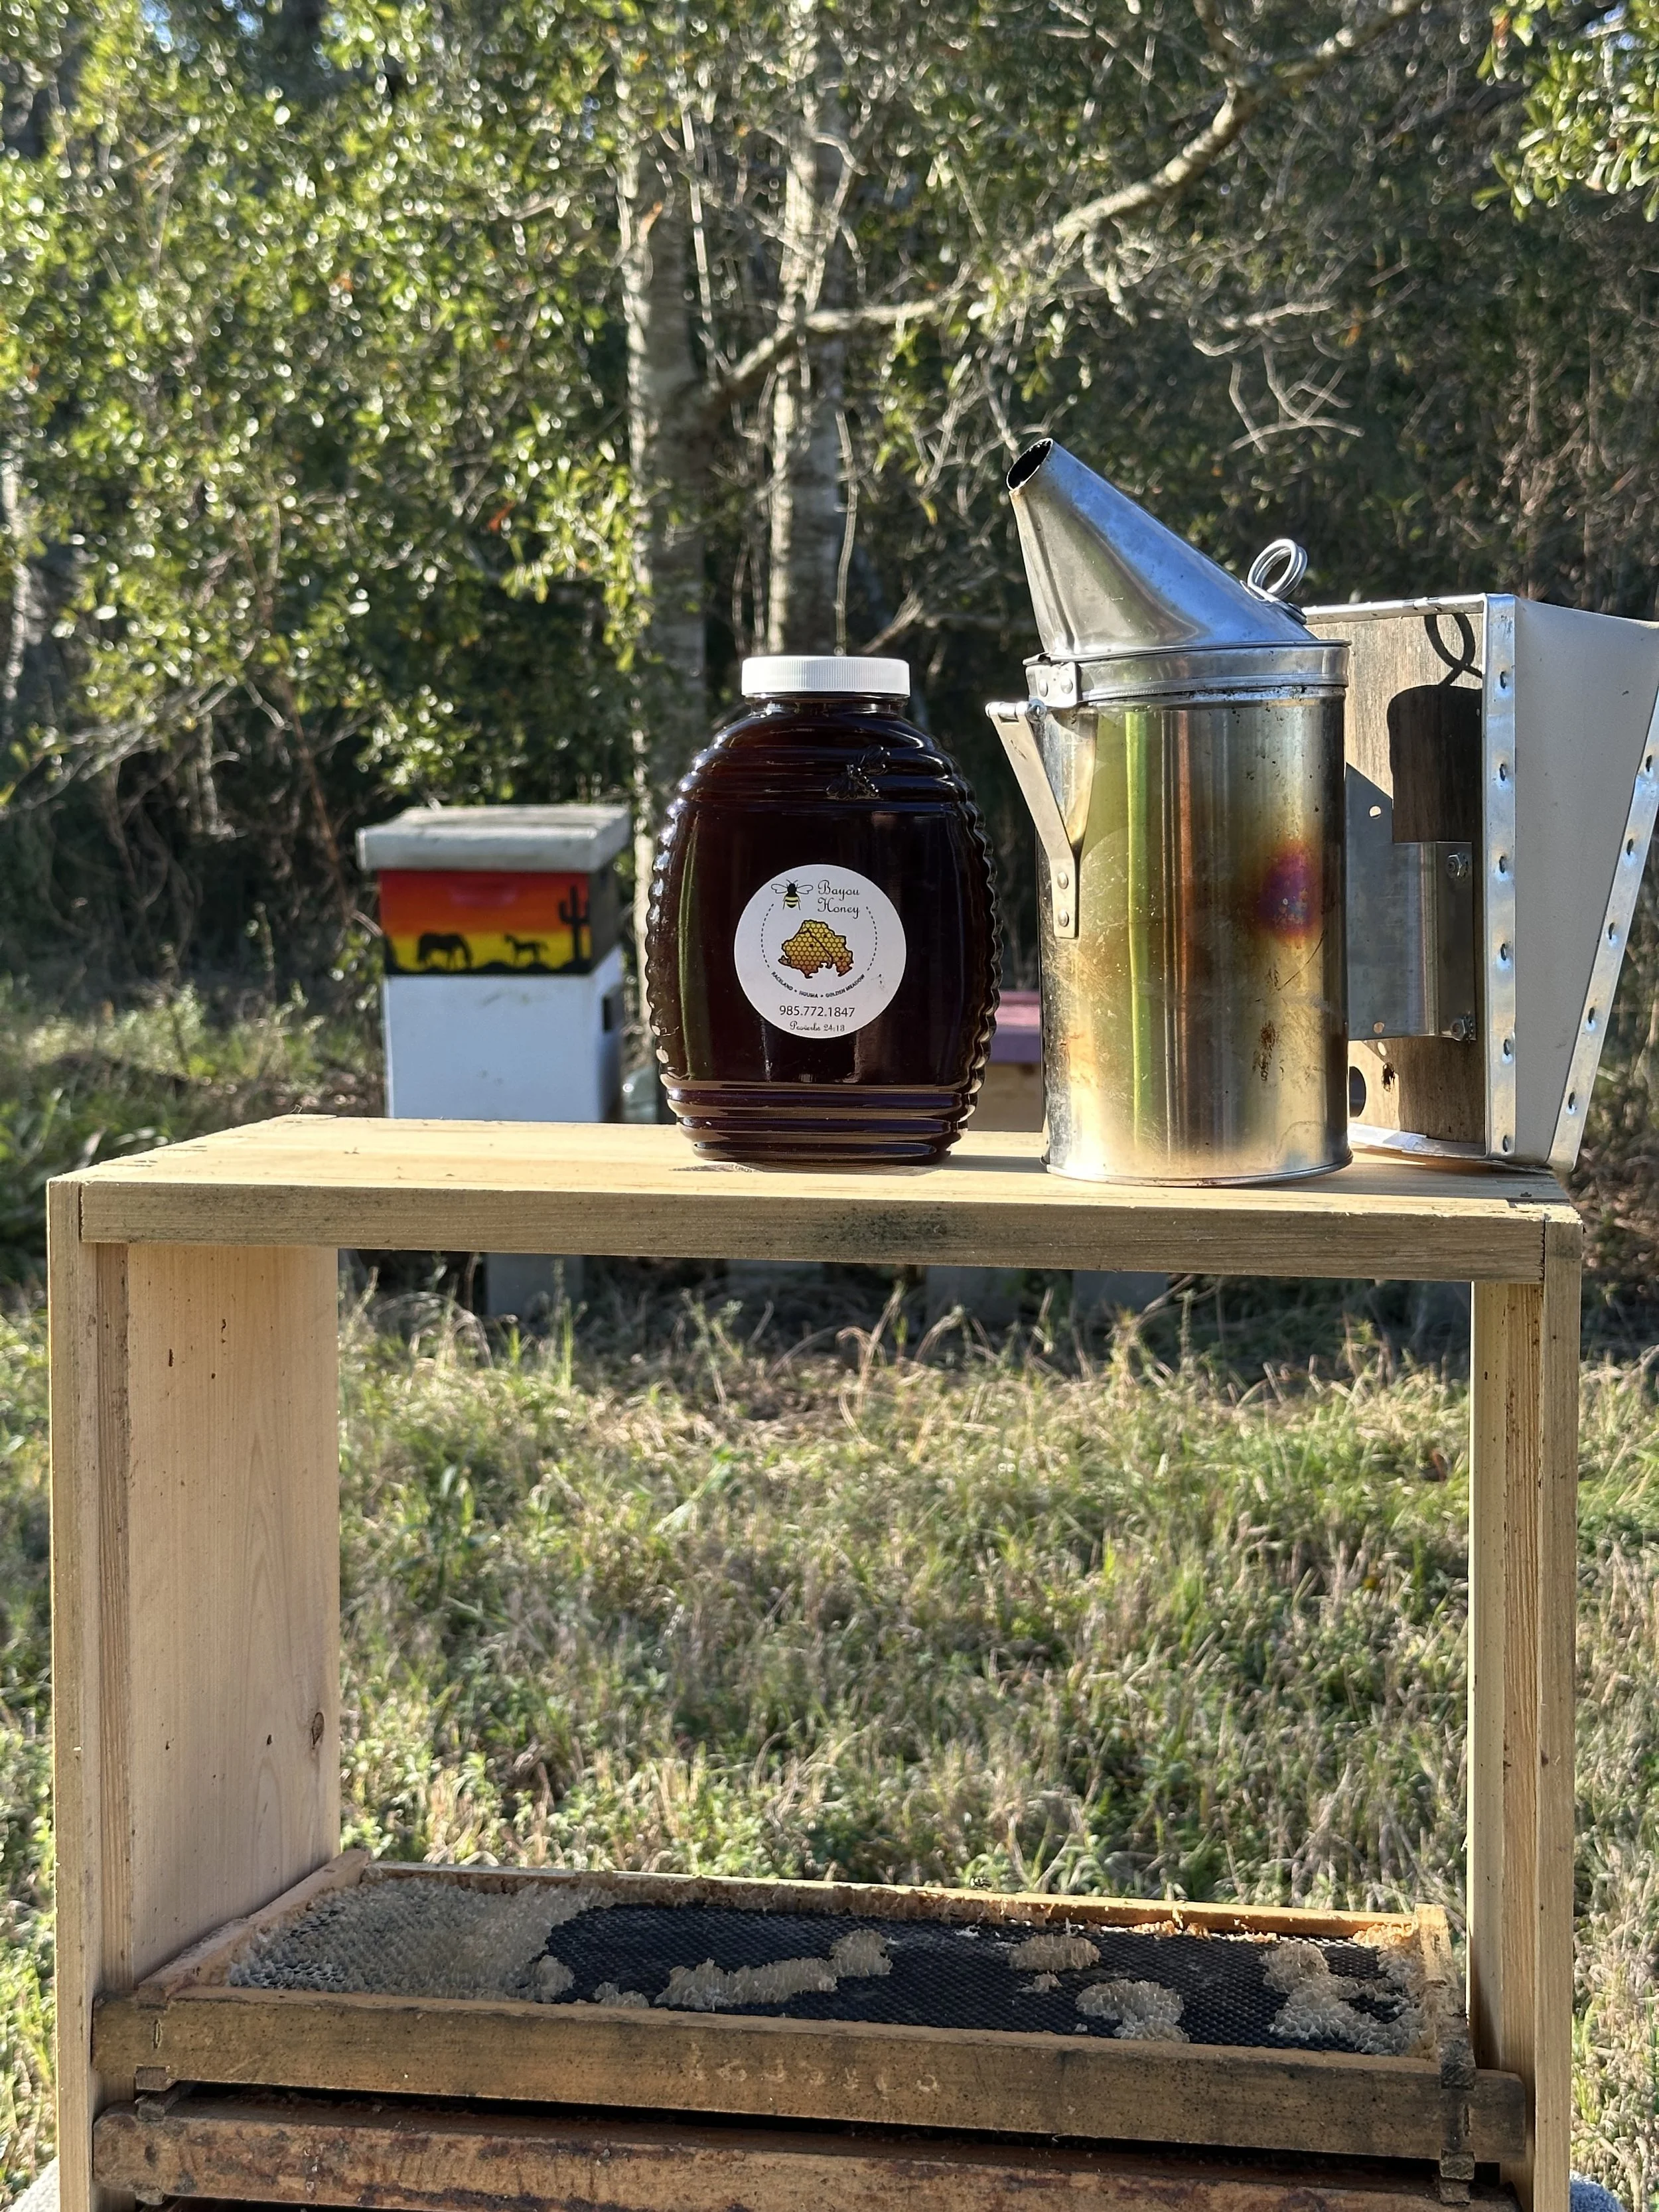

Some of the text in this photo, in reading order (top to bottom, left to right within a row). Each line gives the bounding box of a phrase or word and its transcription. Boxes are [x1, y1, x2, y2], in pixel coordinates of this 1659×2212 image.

[818, 879, 860, 901] Bayou
[817, 897, 860, 919] Honey
[771, 971, 793, 991] RACELAND
[825, 988, 845, 998] GOLDEN
[845, 973, 865, 992] MEADOW
[779, 1005, 855, 1017] 985.772.1847
[790, 1020, 845, 1032] Proverbs 24:13
